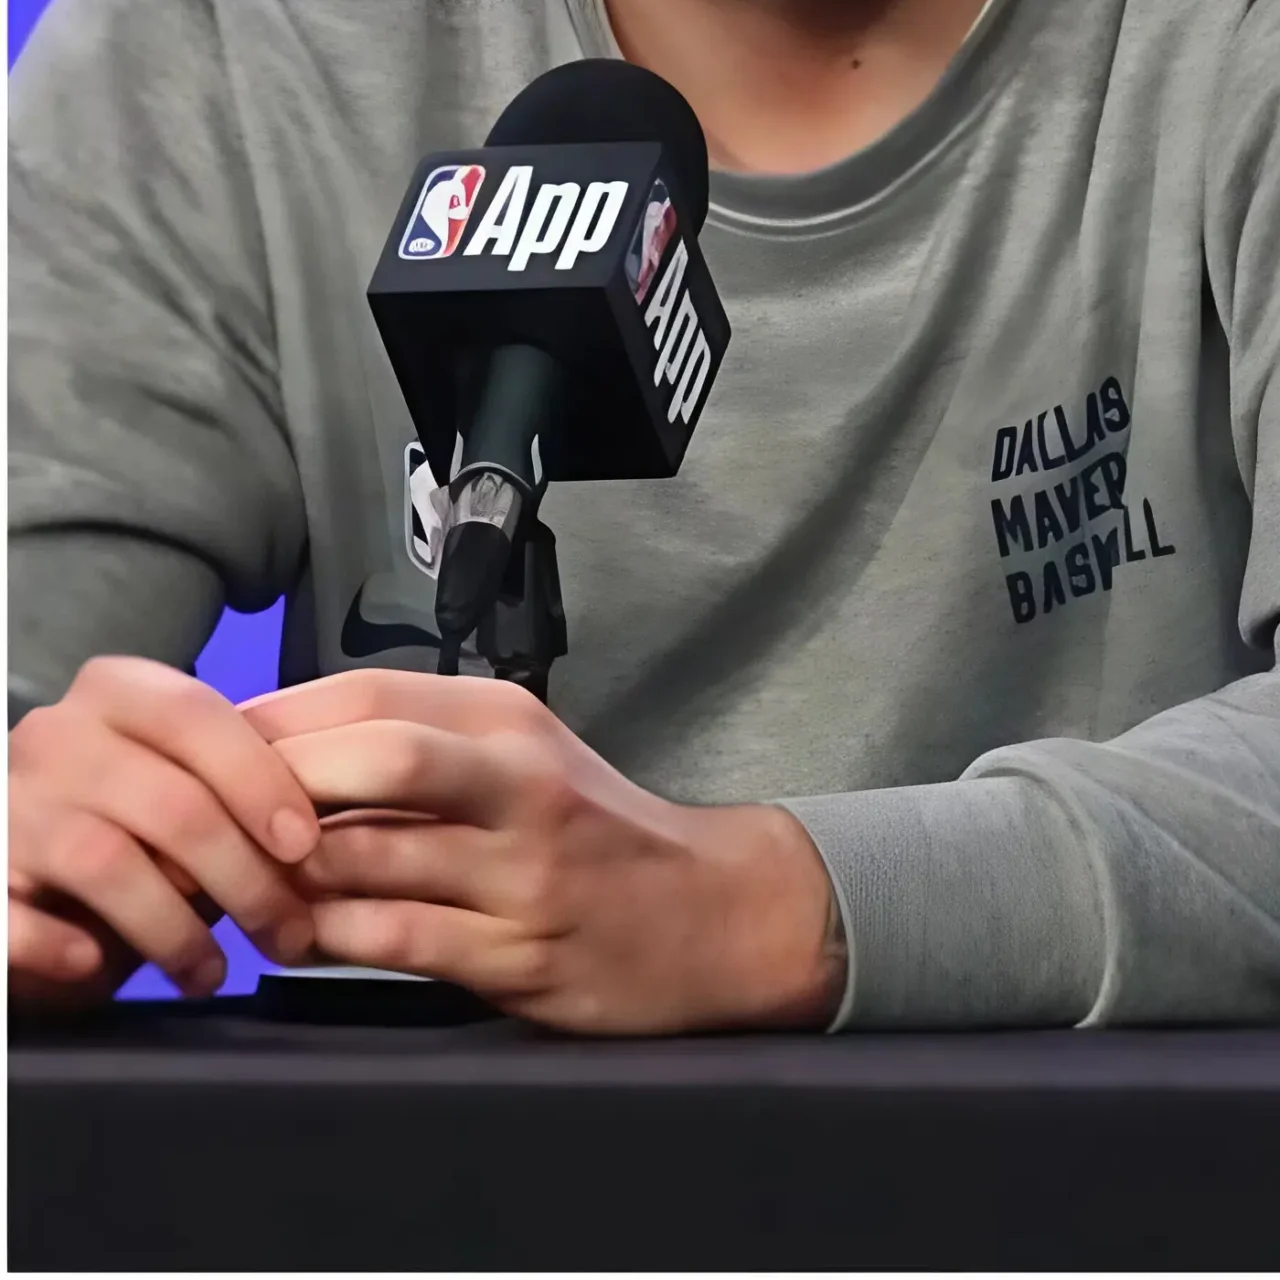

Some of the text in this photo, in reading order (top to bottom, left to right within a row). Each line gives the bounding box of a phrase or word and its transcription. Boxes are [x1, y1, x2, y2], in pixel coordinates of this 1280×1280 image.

[463, 165, 630, 272] App
[644, 236, 712, 424] App
[990, 375, 1131, 483] DALLAS
